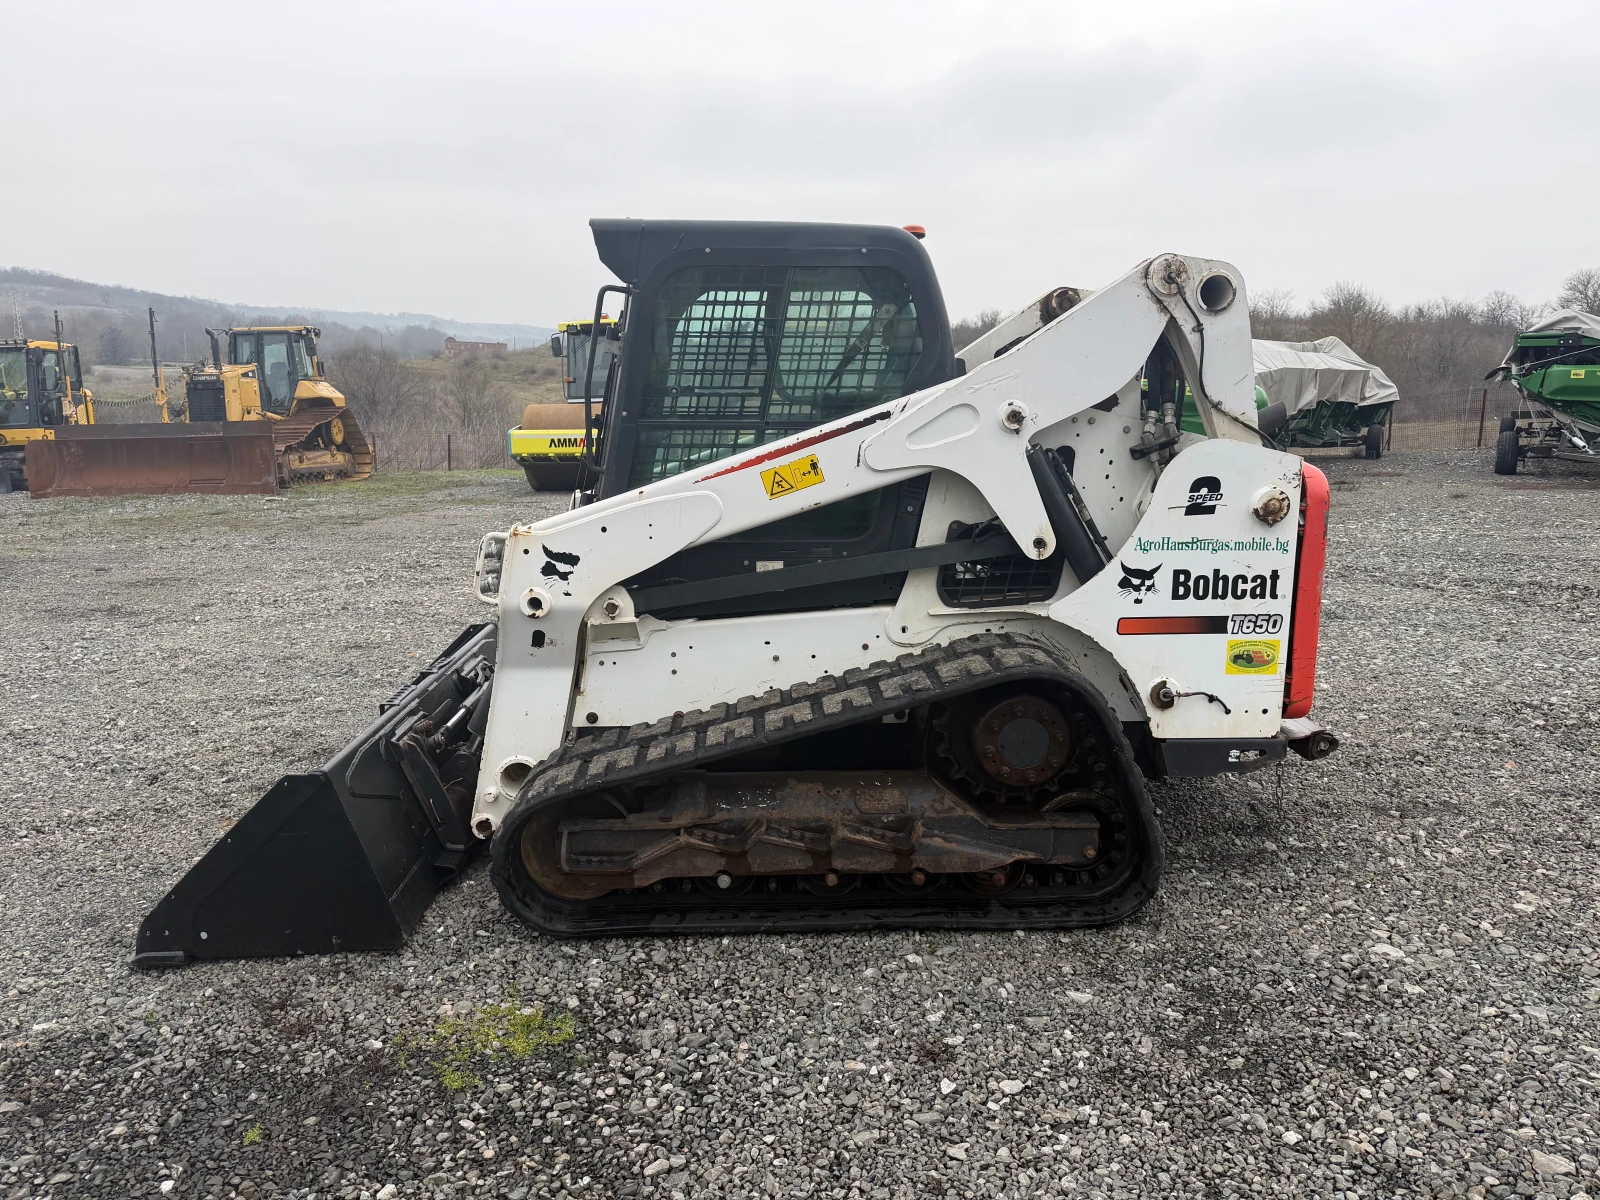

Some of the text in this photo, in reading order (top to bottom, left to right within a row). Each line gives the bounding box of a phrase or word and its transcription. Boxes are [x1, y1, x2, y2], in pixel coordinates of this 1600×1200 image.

[1184, 476, 1221, 516] 2
[1187, 493, 1224, 503] SPEED
[1134, 536, 1289, 554] AgroHausBurgas.mobile.bg
[1171, 568, 1280, 601] Bobcat
[1231, 613, 1283, 635] T650
